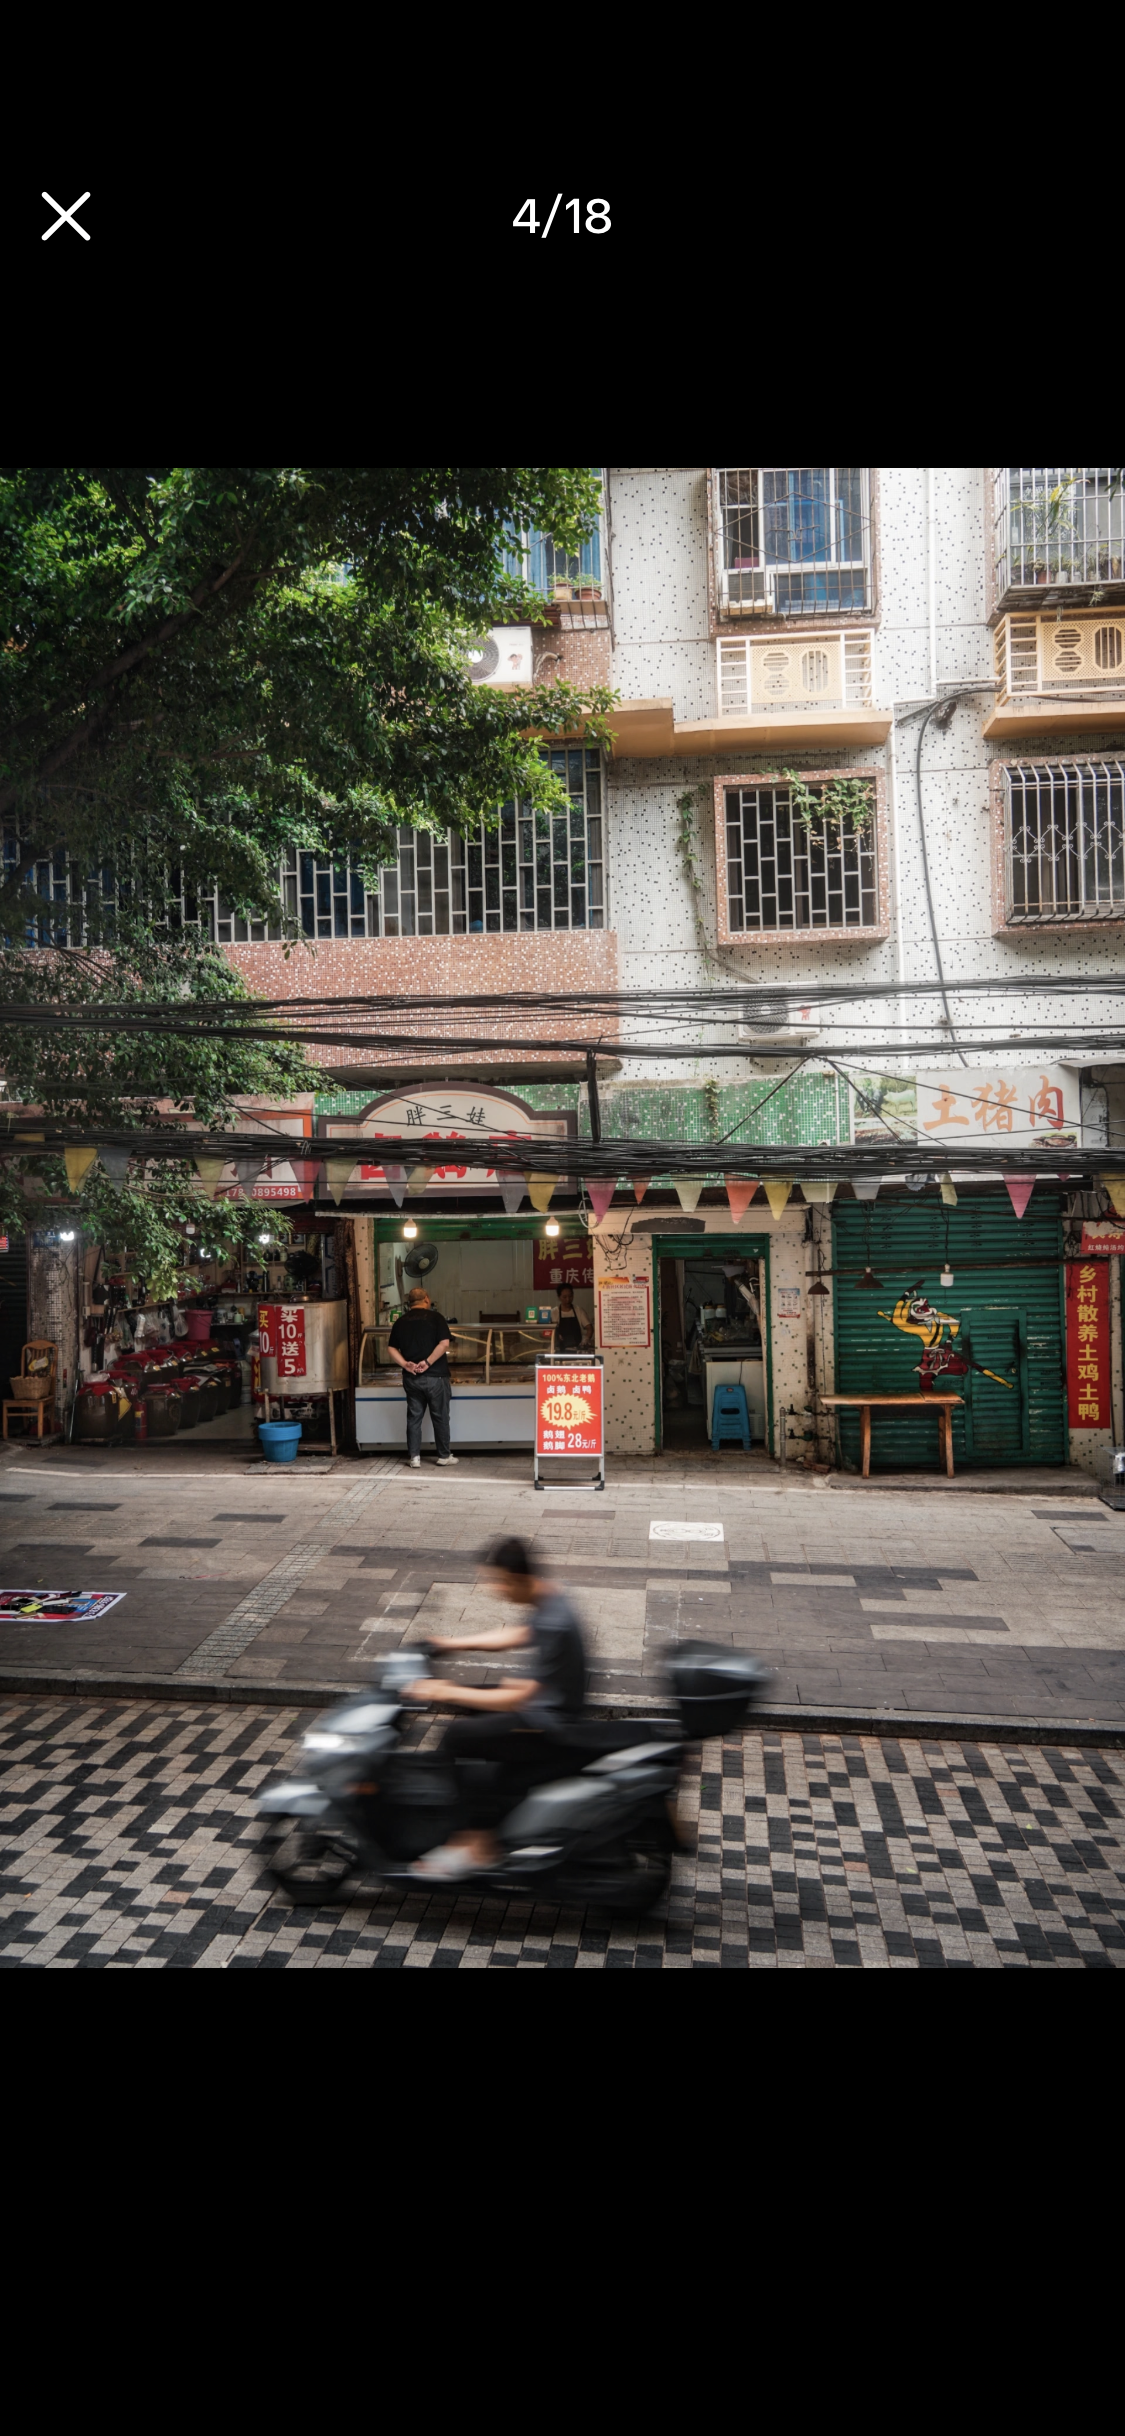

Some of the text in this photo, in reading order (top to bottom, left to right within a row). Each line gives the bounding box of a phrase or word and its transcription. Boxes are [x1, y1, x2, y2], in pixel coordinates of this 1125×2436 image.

[922, 1074, 1065, 1133] 土猪肉
[406, 1105, 486, 1127] 胖三娃
[225, 1187, 297, 1197] 1780895498
[281, 1341, 299, 1356] 送
[1076, 1265, 1100, 1421] 乡村散养土鸡土鸭
[542, 1373, 596, 1383] 100%东北老鹅
[567, 1432, 597, 1449] 28元/斤
